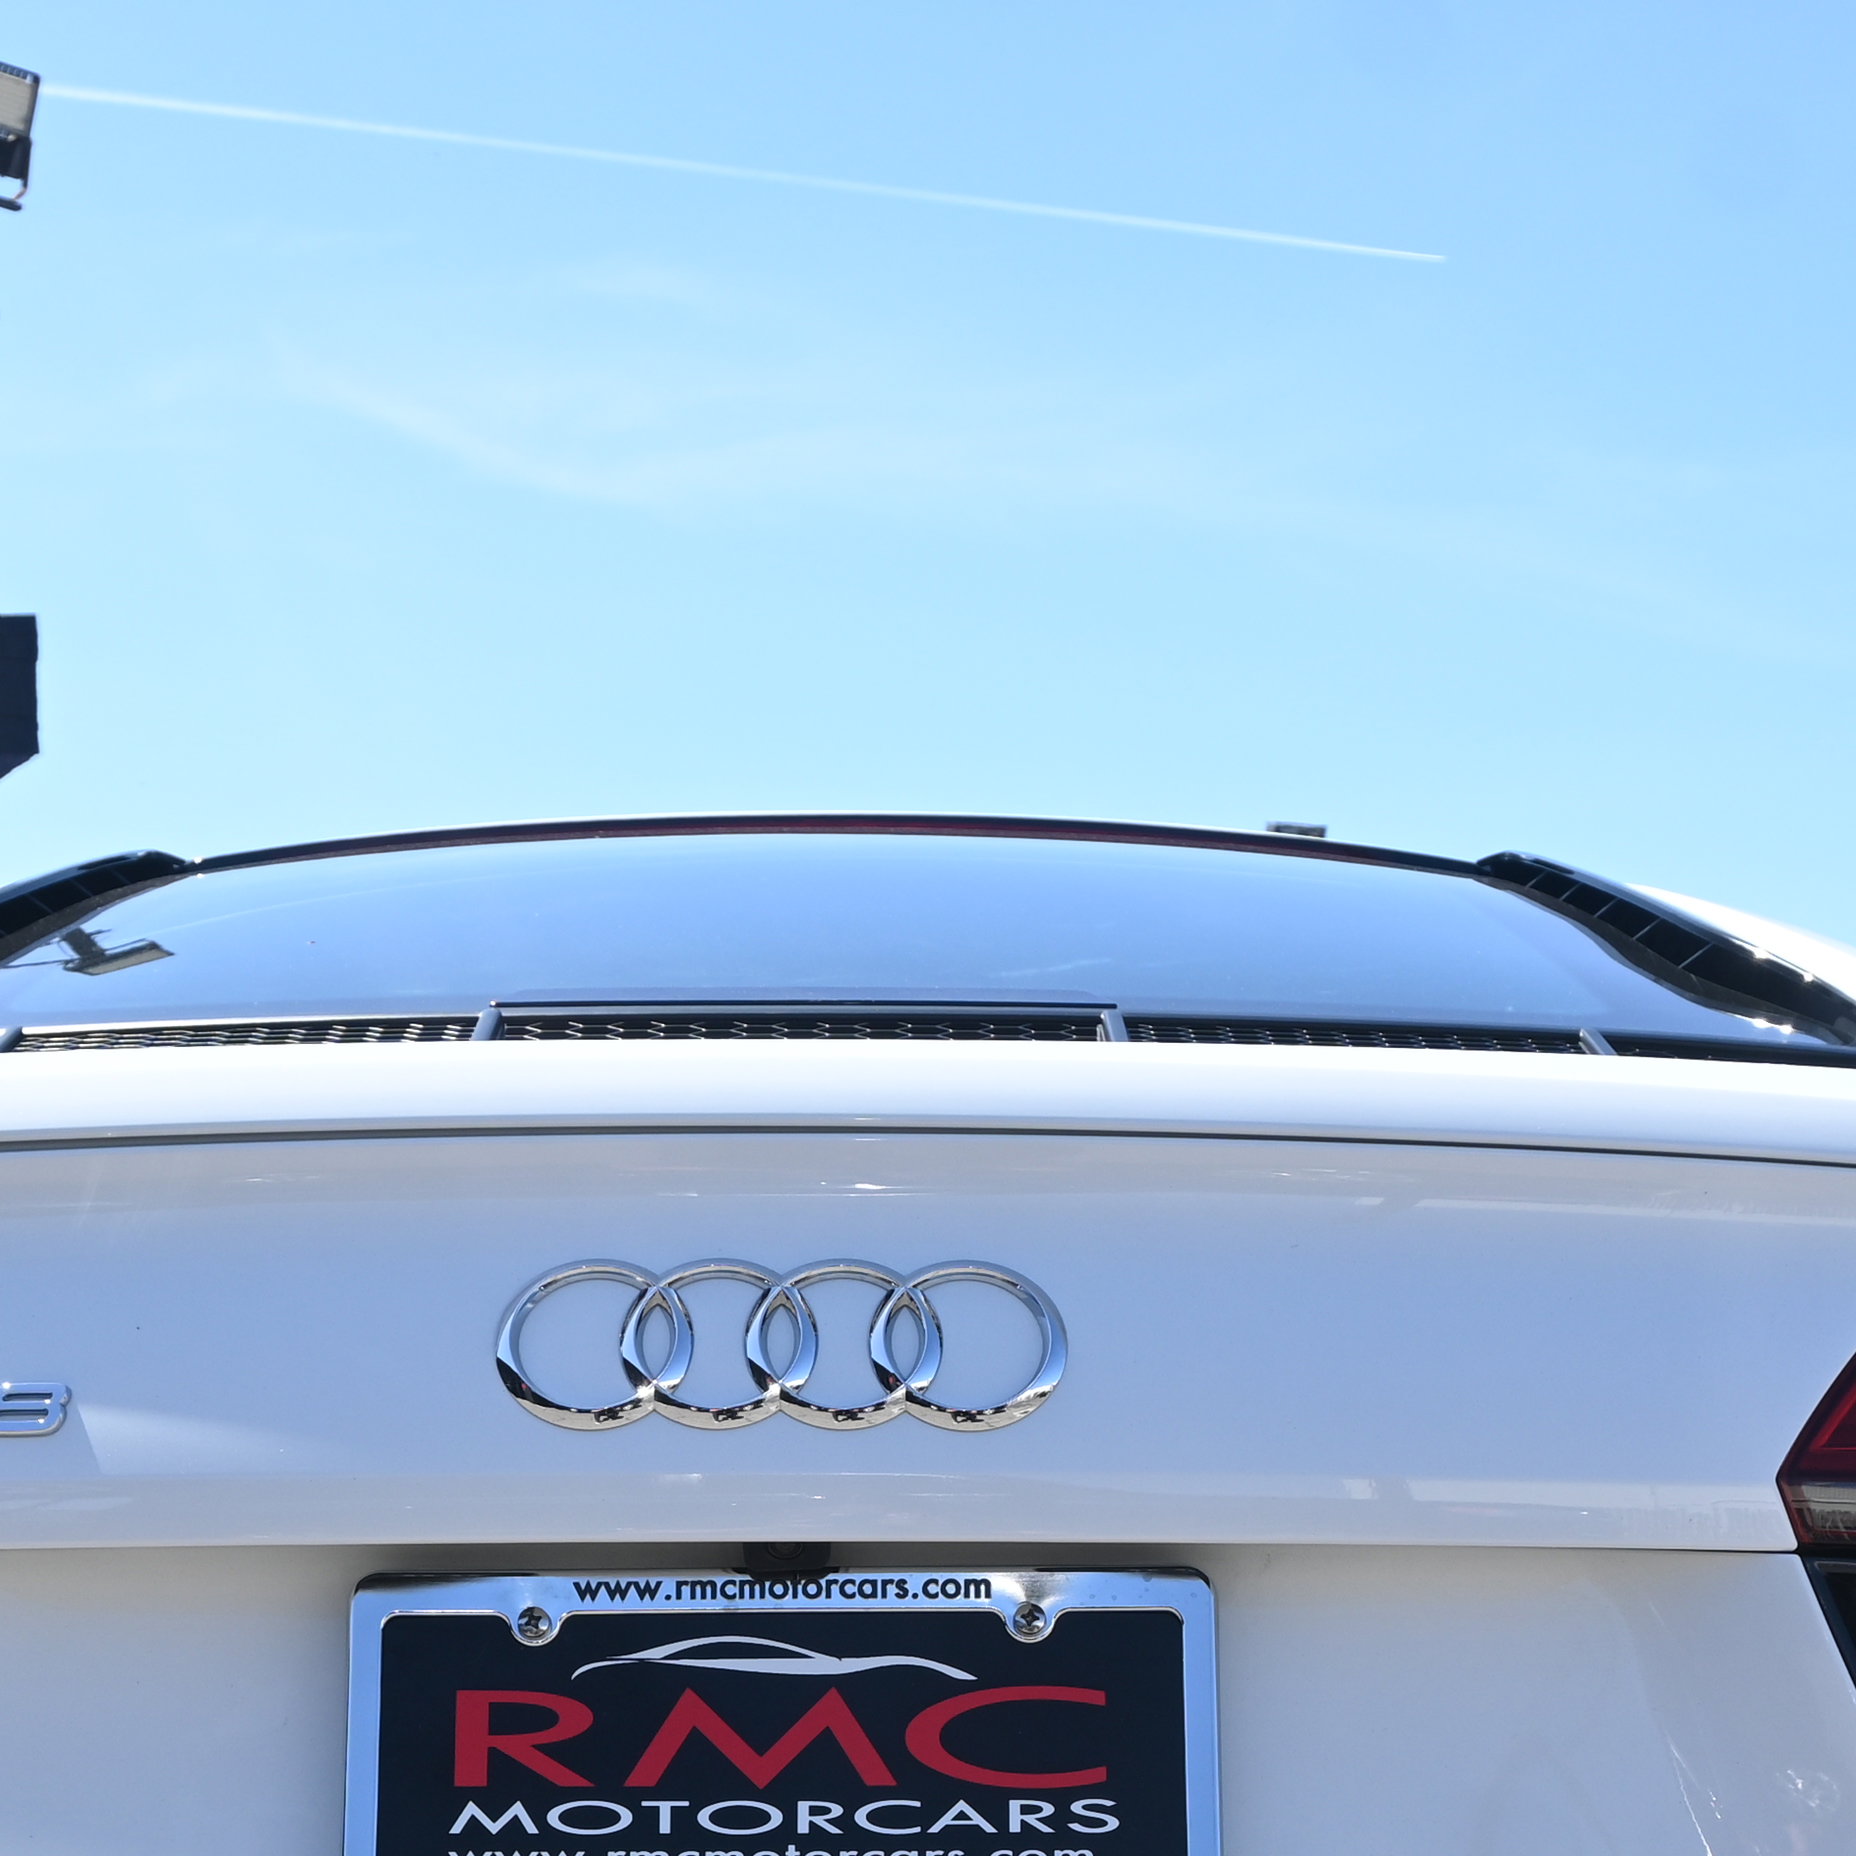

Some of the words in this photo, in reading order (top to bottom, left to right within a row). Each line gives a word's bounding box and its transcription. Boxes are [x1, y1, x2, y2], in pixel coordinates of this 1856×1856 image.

[572, 1576, 992, 1603] www.rmcmotorcars.com
[452, 1686, 1108, 1790] RMC
[447, 1800, 1121, 1836] MOTORCARS
